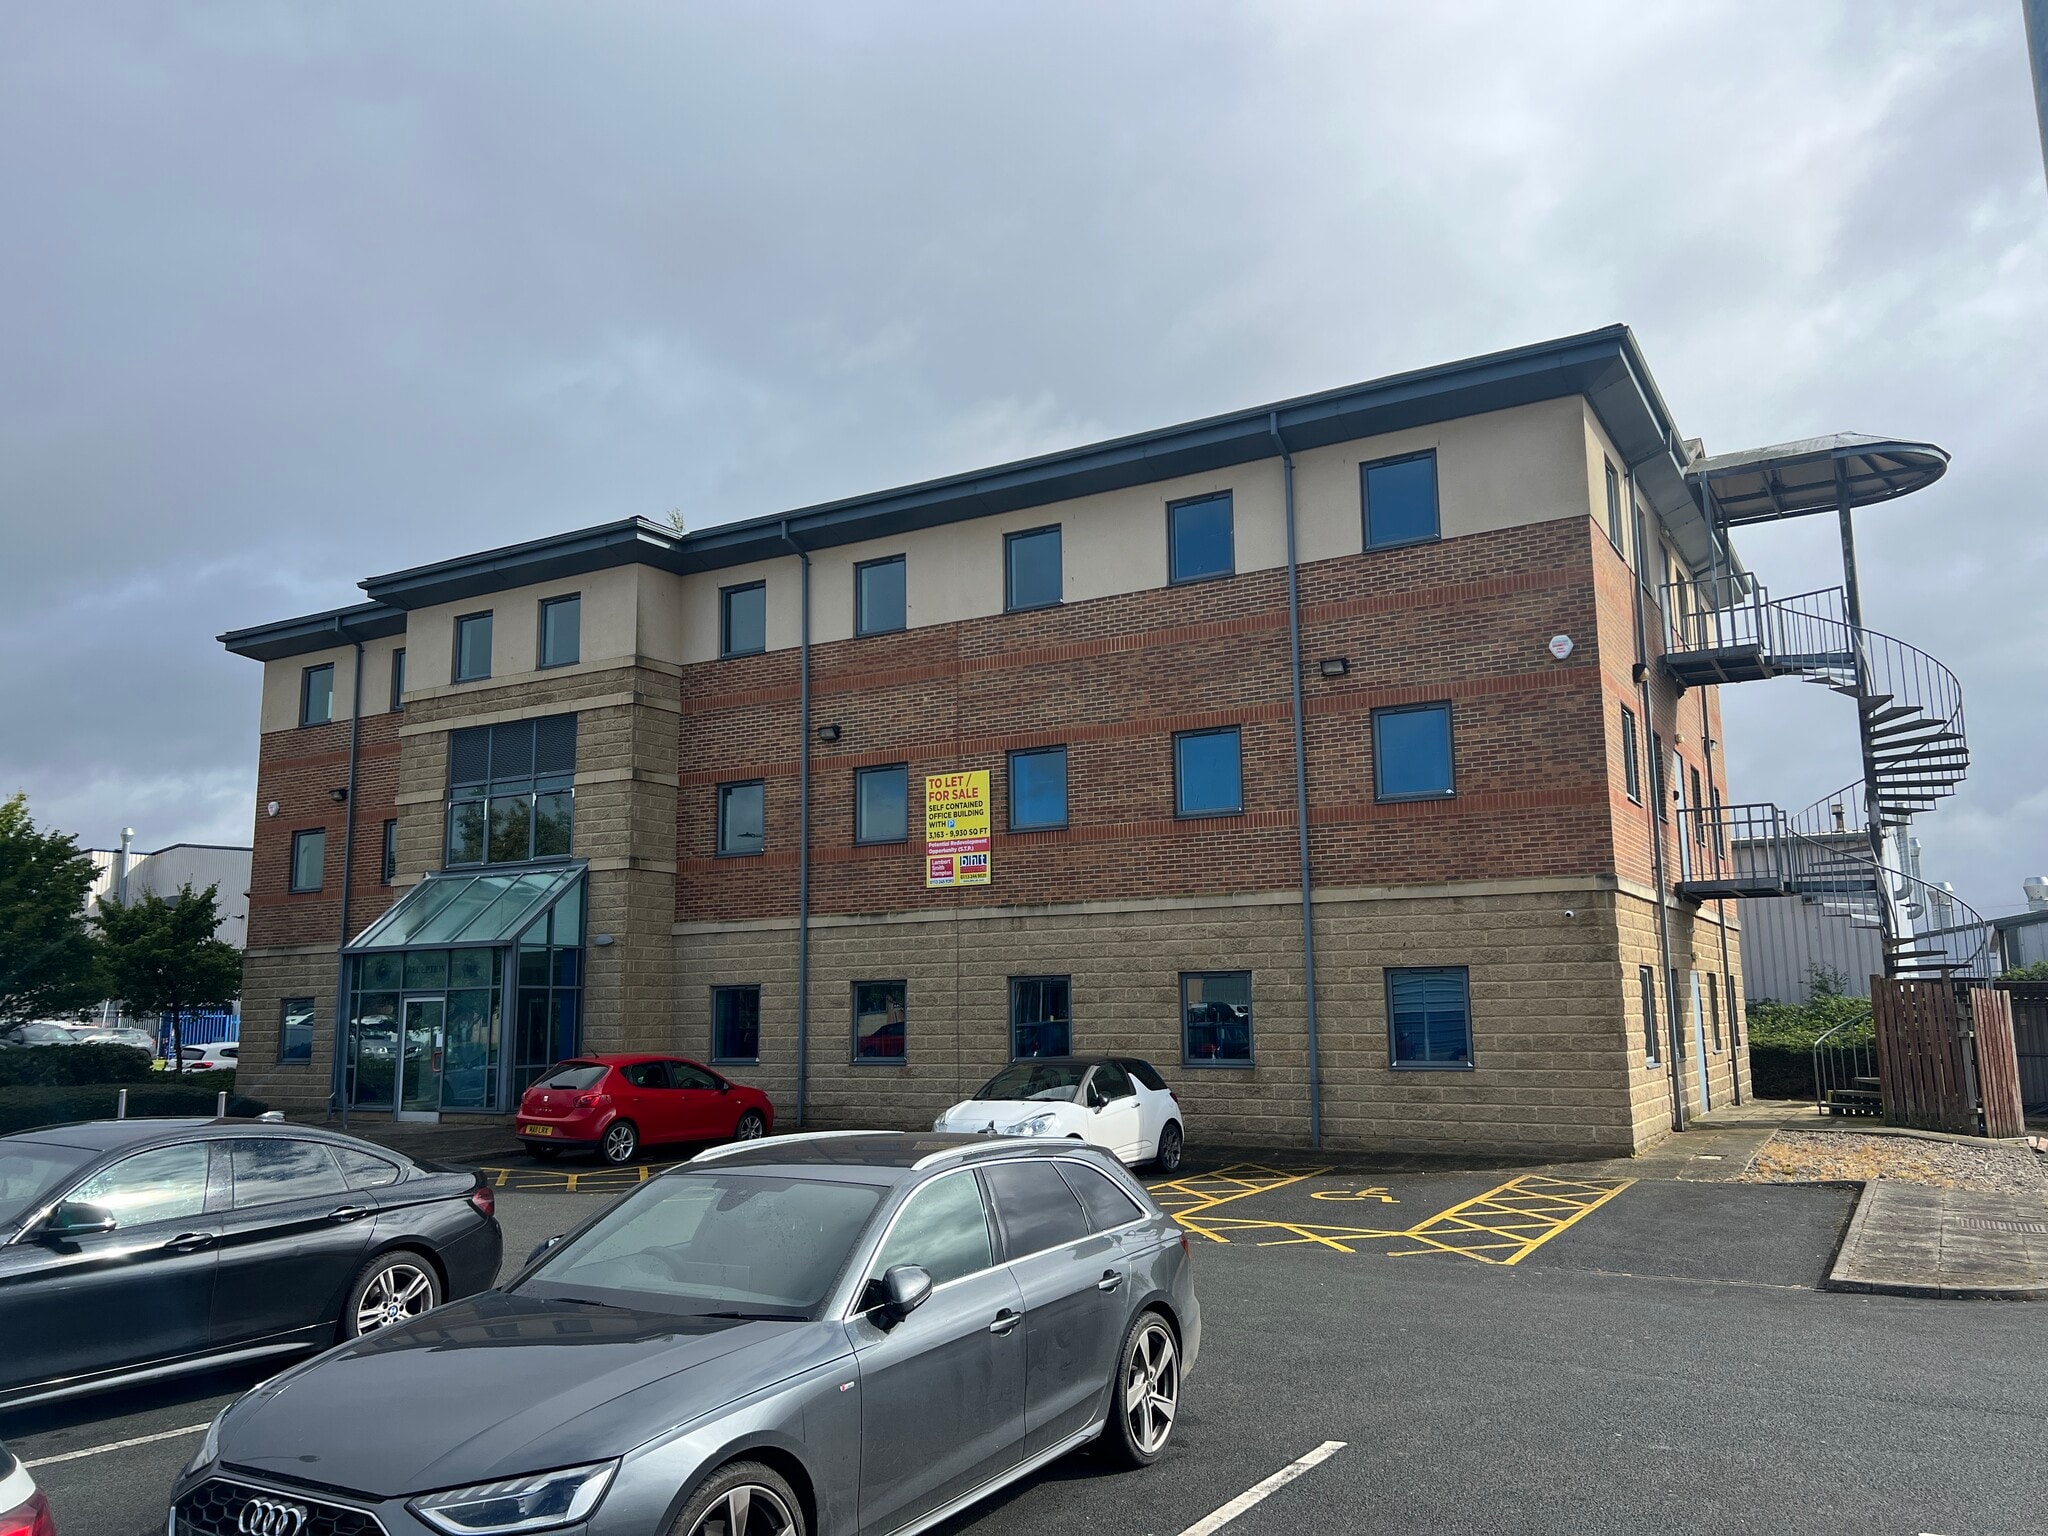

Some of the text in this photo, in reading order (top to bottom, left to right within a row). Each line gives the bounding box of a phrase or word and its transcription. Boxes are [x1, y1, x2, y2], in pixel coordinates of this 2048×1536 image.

[929, 773, 972, 789] TO LET /
[929, 787, 978, 802] FOR SALE
[946, 800, 984, 810] CONTAINED
[928, 809, 984, 820] OFFICE BUILDING
[950, 829, 968, 838] 9,930
